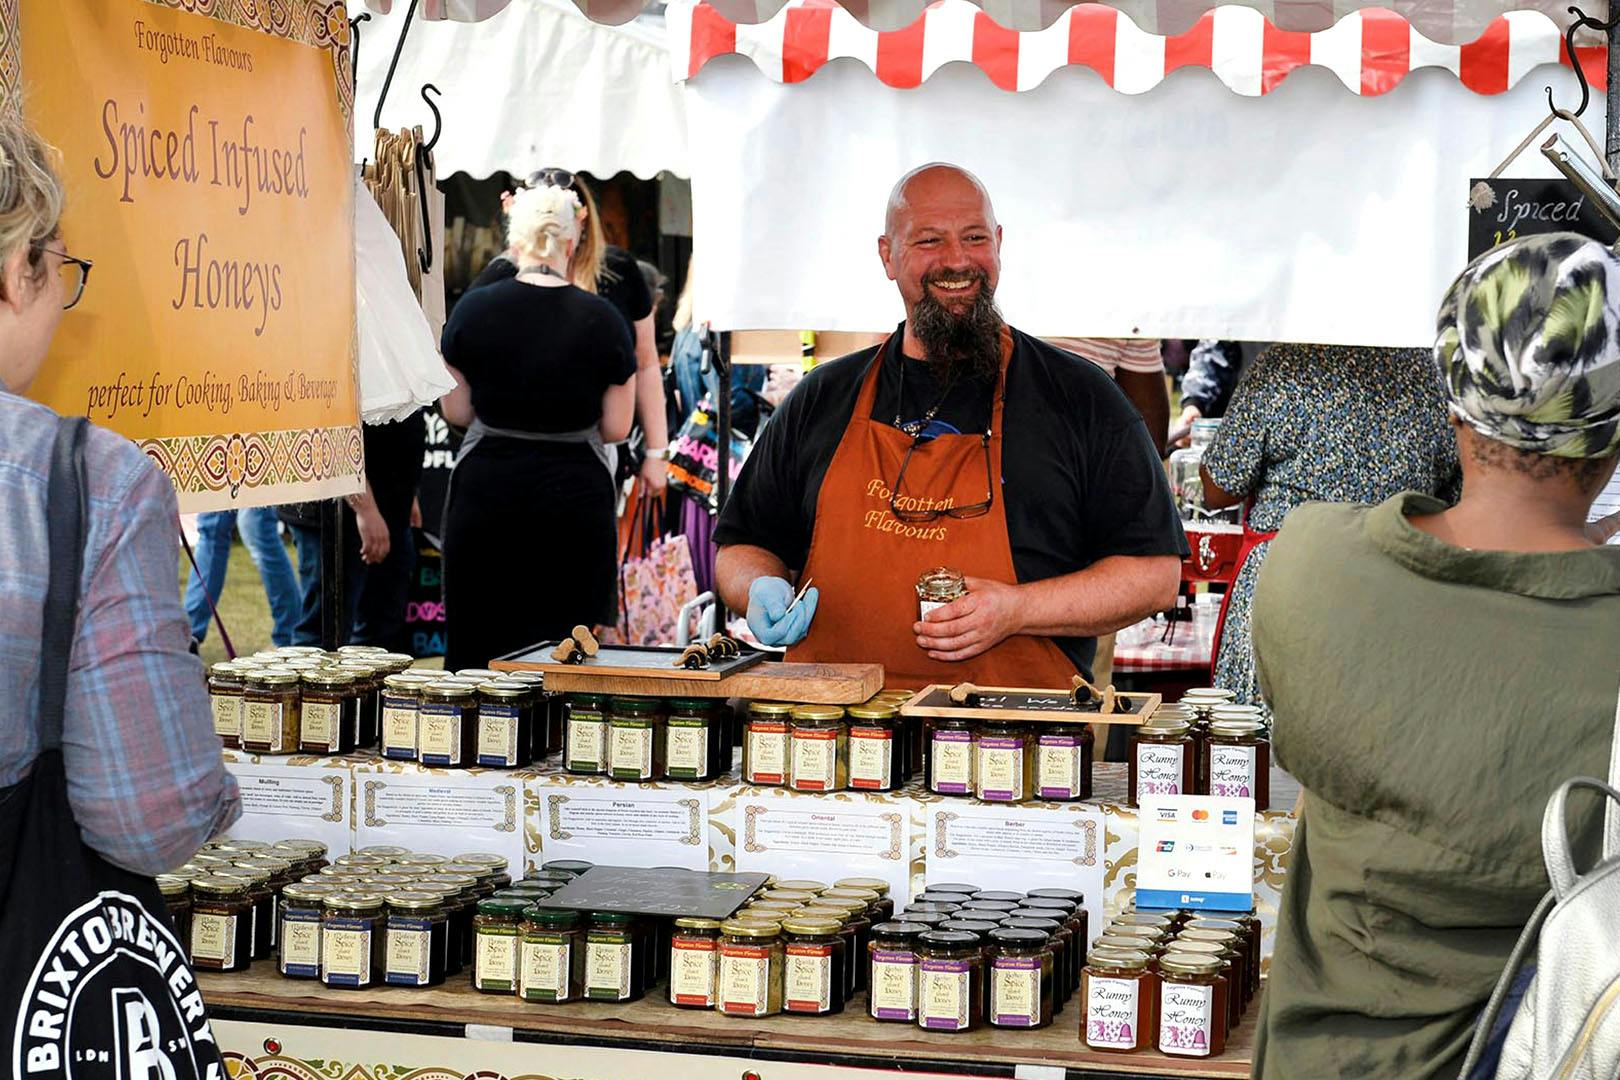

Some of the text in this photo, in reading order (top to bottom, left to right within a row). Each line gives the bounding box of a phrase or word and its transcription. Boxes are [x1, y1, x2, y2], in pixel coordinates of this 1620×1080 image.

[134, 21, 252, 72] Forgotten Flavours
[94, 99, 310, 215] Spiced Infused
[1497, 190, 1584, 231] Spiced
[173, 234, 282, 336] Honeys
[87, 372, 143, 419] perfect
[143, 372, 173, 417] for
[176, 371, 233, 414] Cooking,
[238, 371, 280, 411] Baking
[284, 369, 296, 402] &
[865, 510, 948, 541] Flavours
[1140, 752, 1178, 767] Runny
[1213, 754, 1249, 769] Runny
[1140, 768, 1178, 783] Honey
[1212, 770, 1250, 784] Honey
[27, 916, 117, 1072] BRIXTO
[1091, 987, 1132, 1004] Runny
[1165, 993, 1206, 1010] Runny
[1091, 1005, 1132, 1023] Honey
[1164, 1011, 1206, 1029] Honey
[76, 1050, 108, 1062] LDN
